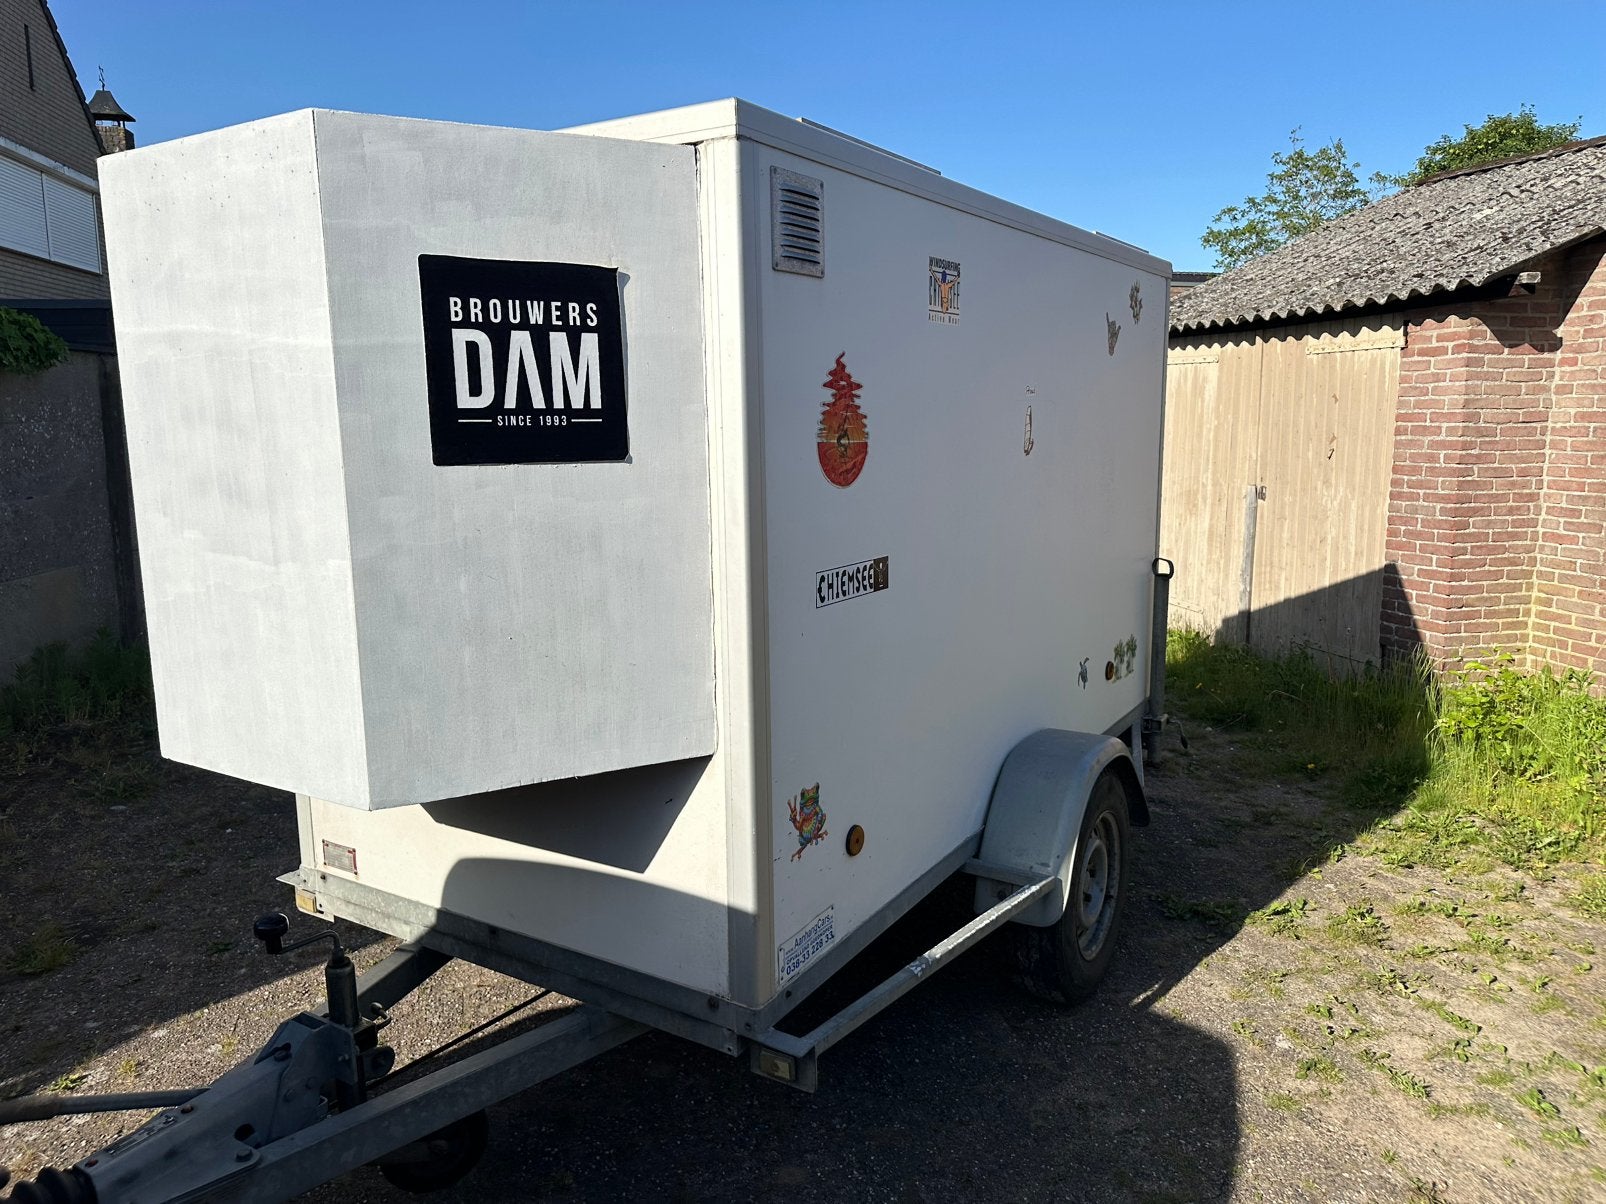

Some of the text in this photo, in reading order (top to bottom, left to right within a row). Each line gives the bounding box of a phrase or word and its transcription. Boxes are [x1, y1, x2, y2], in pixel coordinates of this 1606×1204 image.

[928, 256, 961, 272] WINDSURFING
[449, 296, 598, 327] BROUWERS
[451, 328, 602, 409] DAM
[497, 415, 568, 426] SINCE 1993
[817, 562, 874, 604] CHIEMSEE
[786, 950, 810, 975] 038-33
[825, 931, 835, 943] 33
